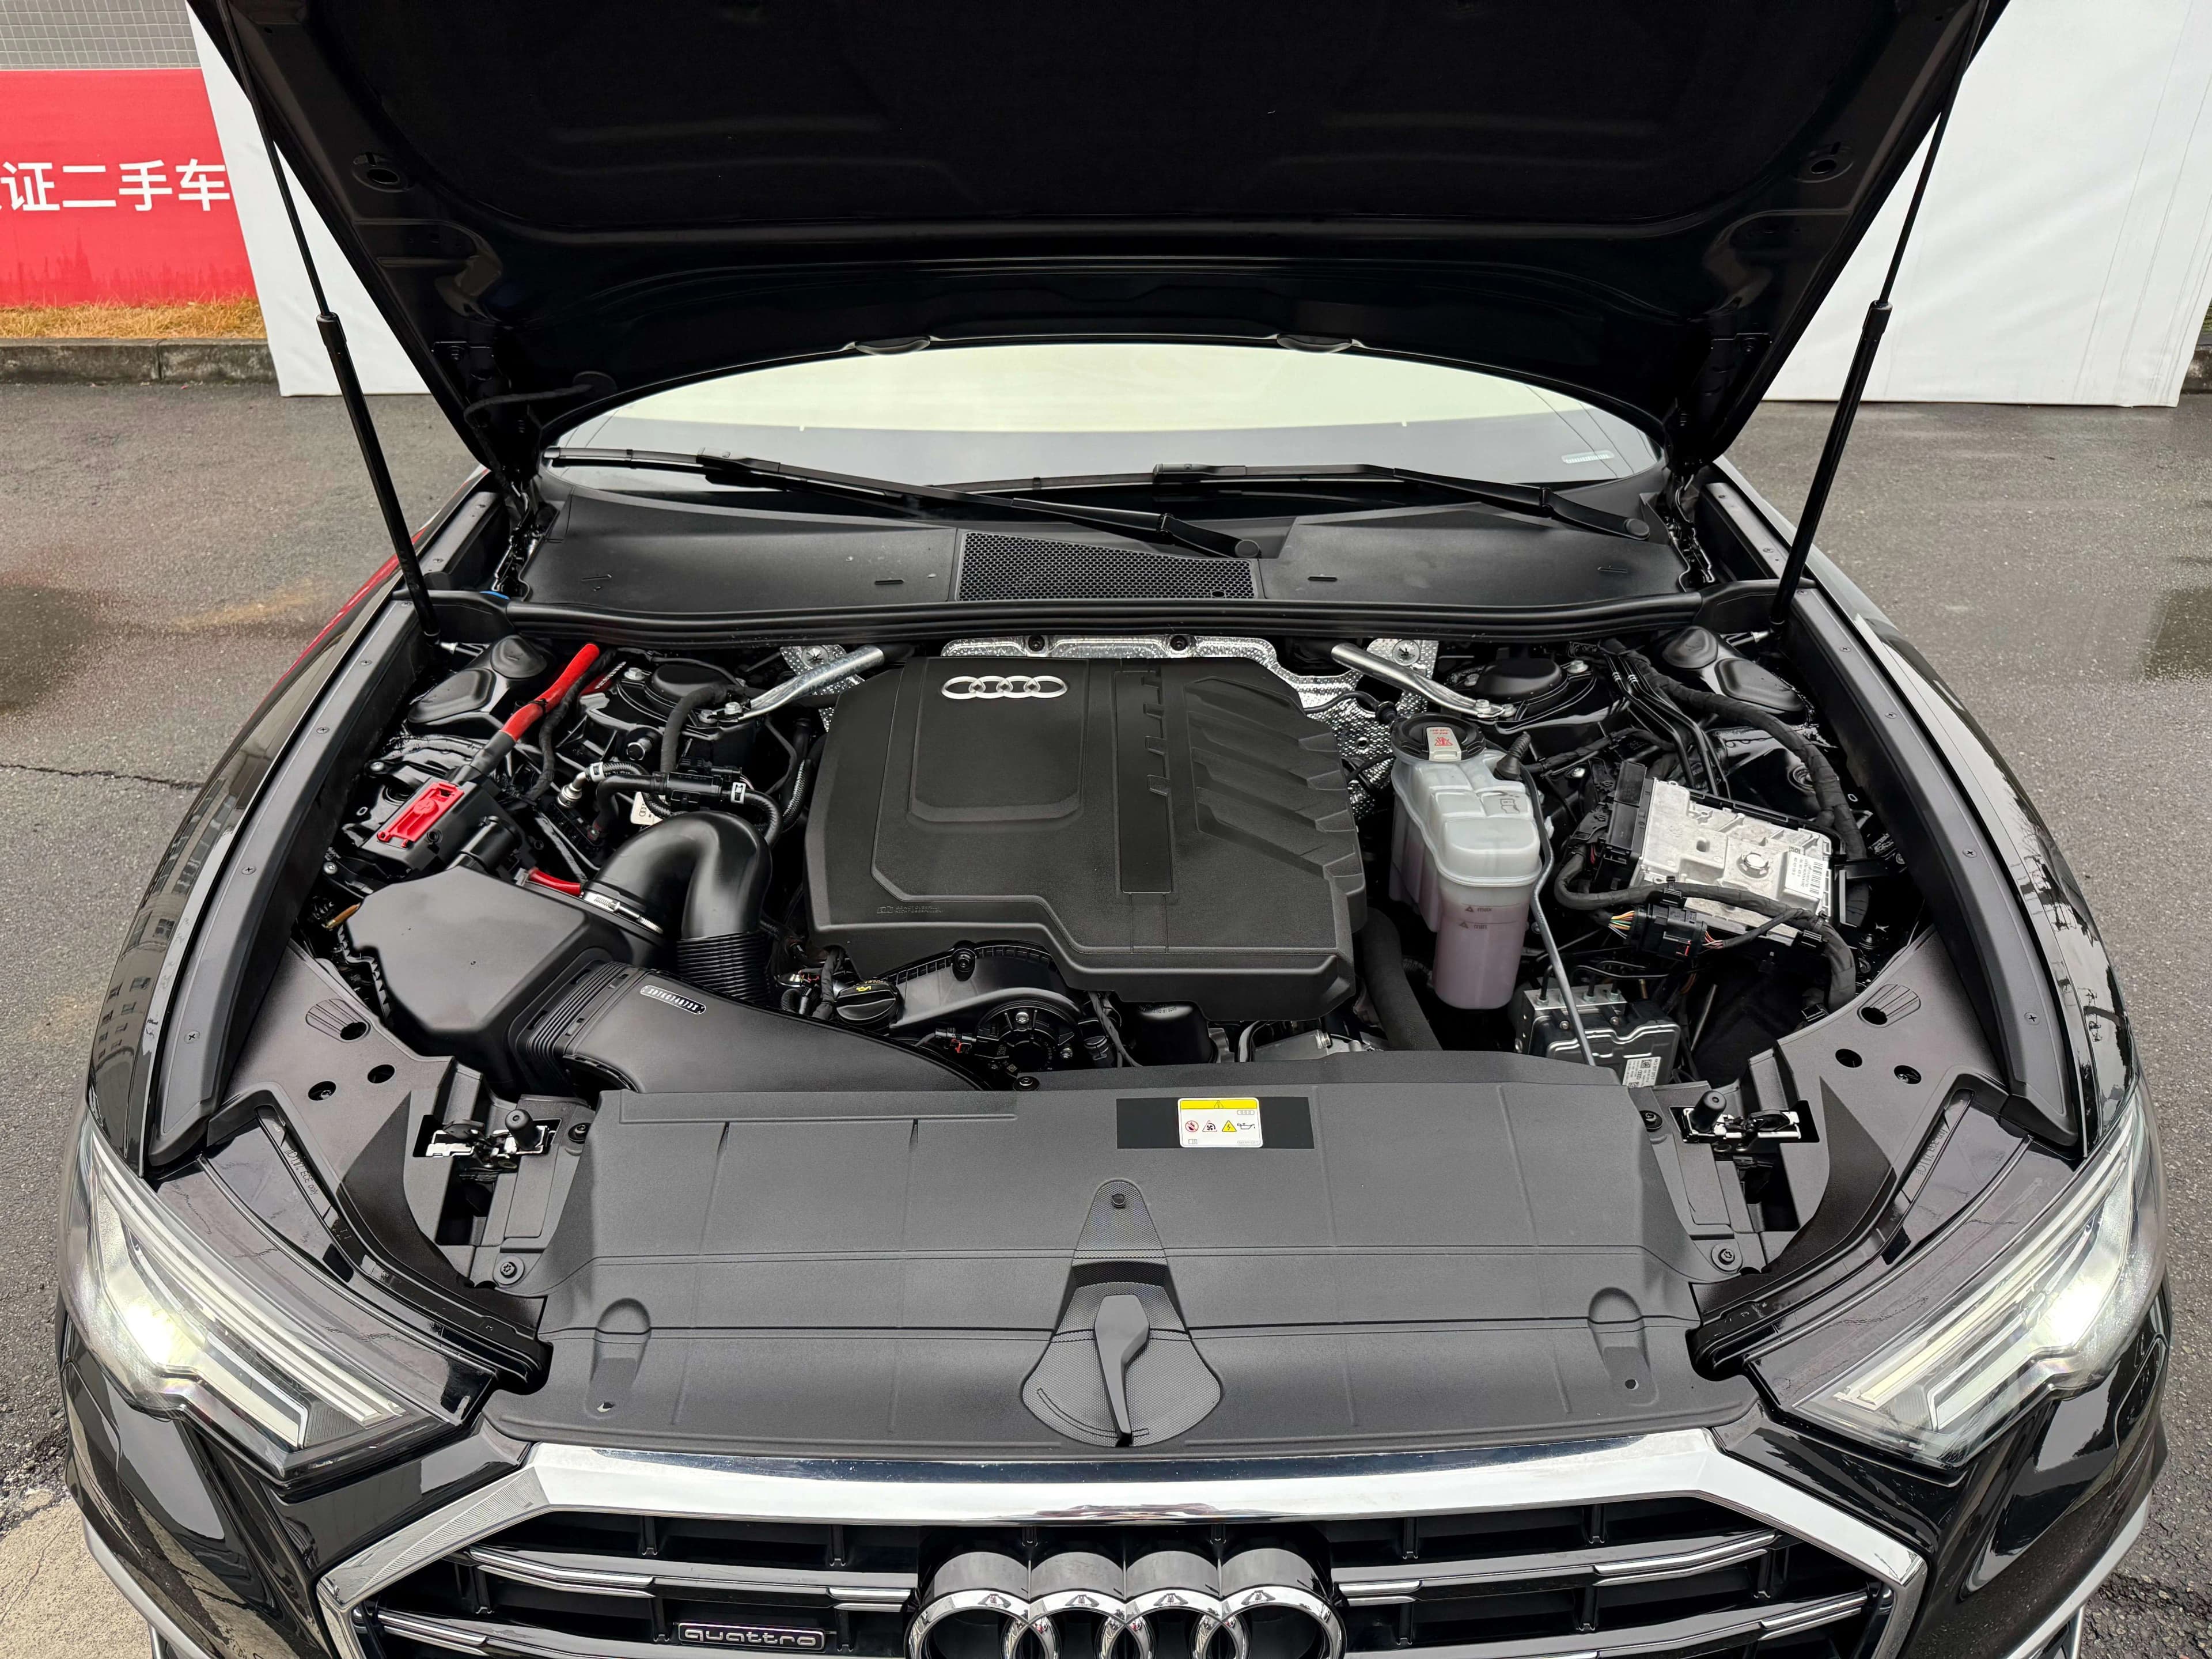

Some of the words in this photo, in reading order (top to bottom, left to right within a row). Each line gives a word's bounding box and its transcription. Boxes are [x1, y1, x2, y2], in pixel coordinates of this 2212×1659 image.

[0, 158, 230, 211] 证二手车
[300, 1170, 313, 1183] ECE
[308, 1184, 319, 1195] only
[684, 1628, 816, 1646] quattro
